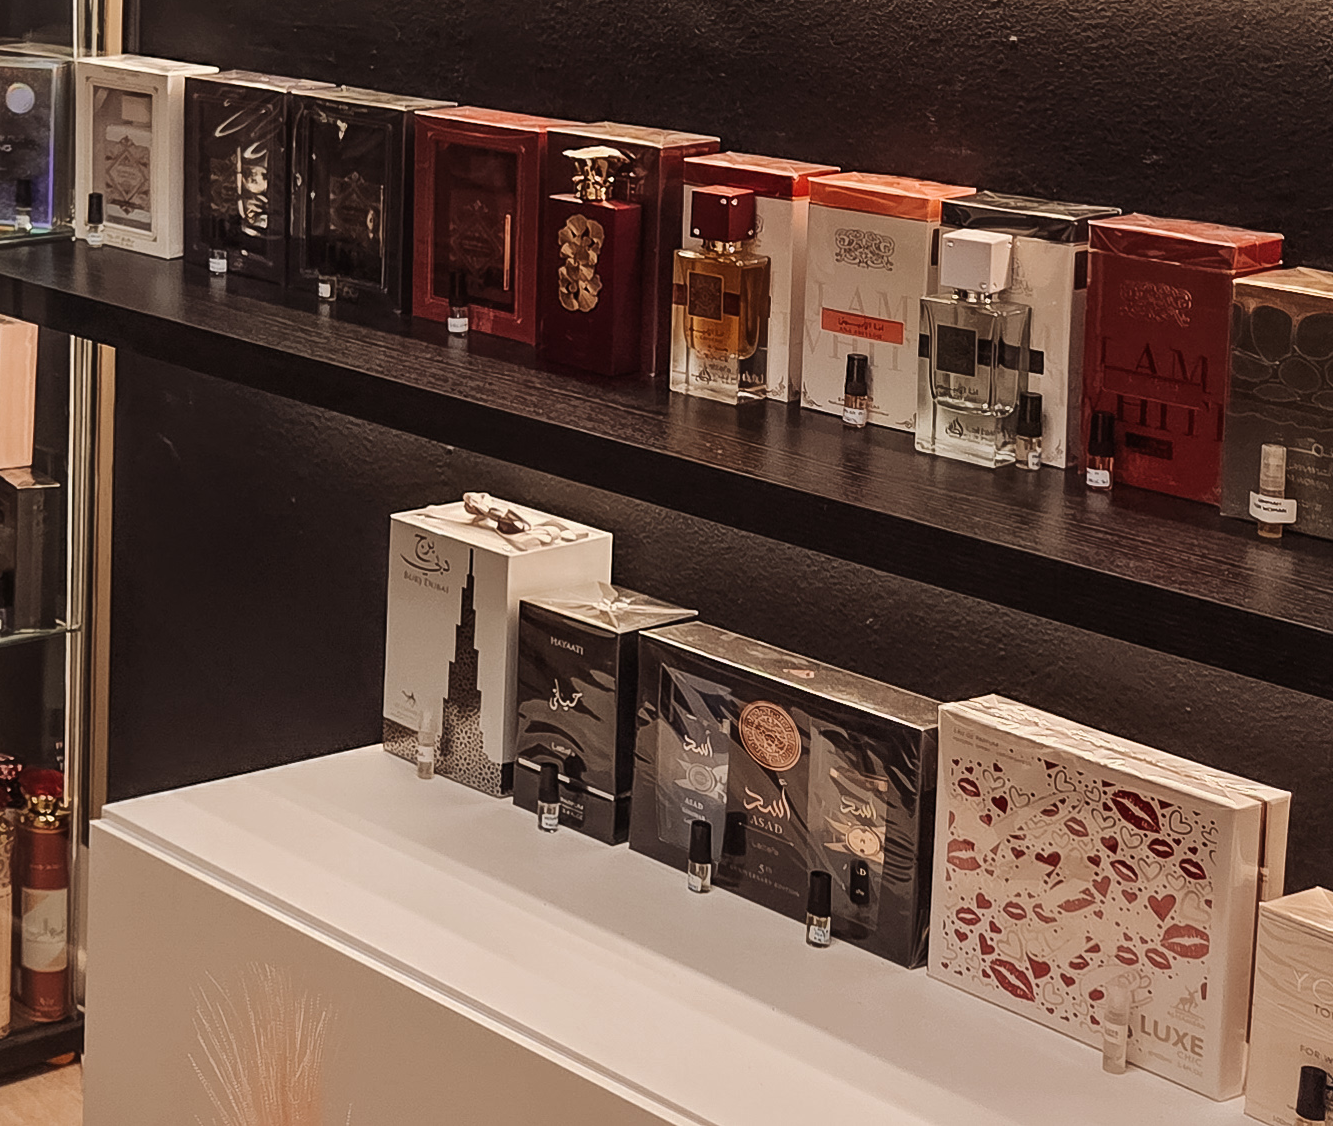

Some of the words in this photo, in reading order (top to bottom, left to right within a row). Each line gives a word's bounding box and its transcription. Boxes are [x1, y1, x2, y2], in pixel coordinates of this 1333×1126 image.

[414, 533, 436, 563] برج
[400, 553, 451, 576] دبي
[742, 777, 792, 823] أسد
[749, 815, 784, 834] ASAD
[1139, 1013, 1204, 1058] LUXE
[1176, 1050, 1204, 1068] CHIC
